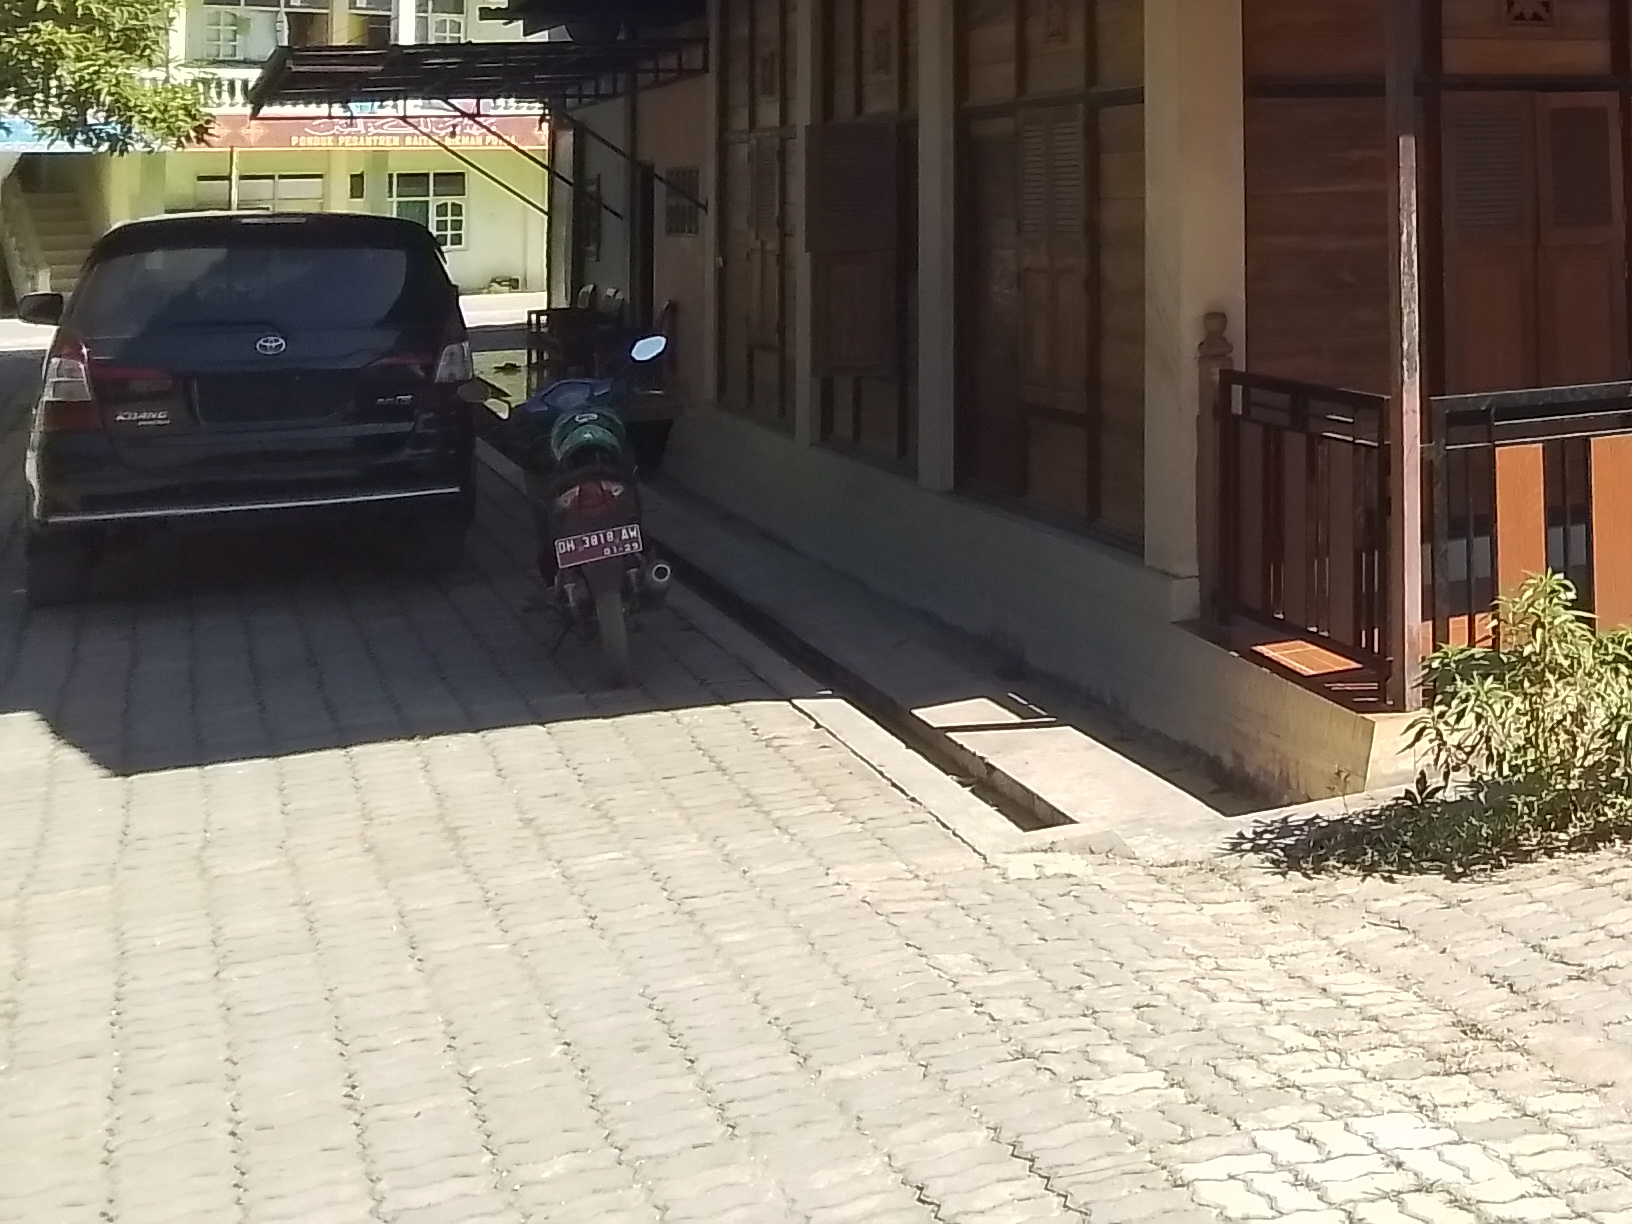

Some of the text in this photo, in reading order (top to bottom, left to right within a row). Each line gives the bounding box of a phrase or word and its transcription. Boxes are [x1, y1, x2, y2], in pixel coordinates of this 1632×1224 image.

[291, 135, 335, 147] PONDOK
[338, 135, 400, 147] PESANTREN
[558, 527, 638, 554] DH 3818 AW
